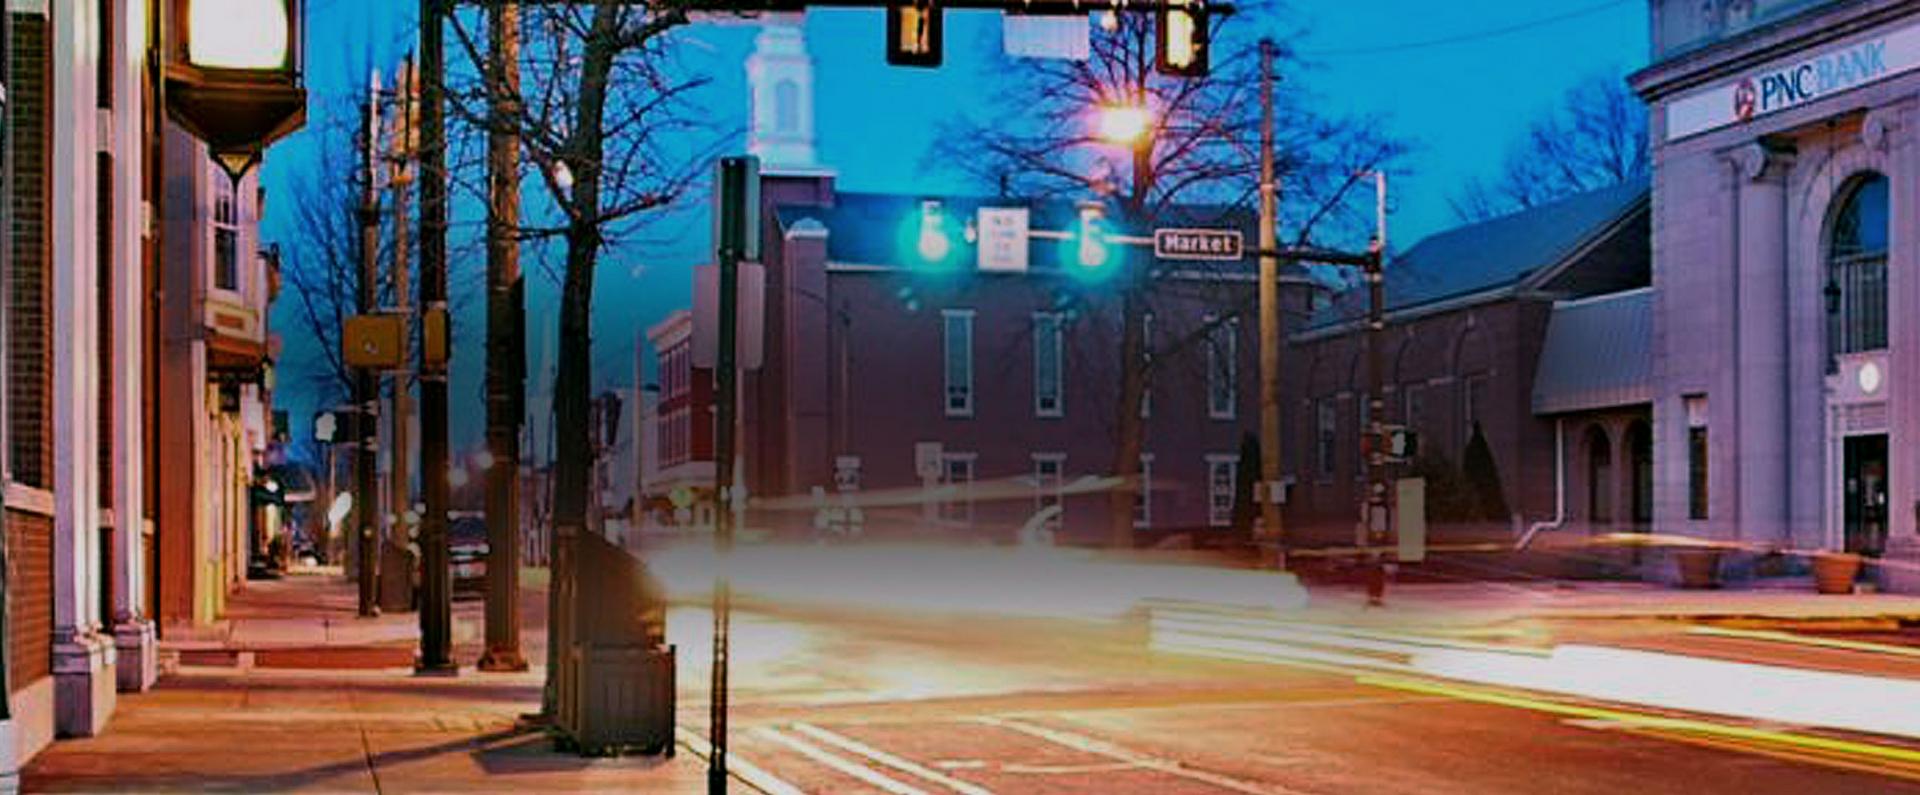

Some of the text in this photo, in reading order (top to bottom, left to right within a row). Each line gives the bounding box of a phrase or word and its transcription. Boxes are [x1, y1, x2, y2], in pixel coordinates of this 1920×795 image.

[1760, 40, 1886, 110] PNC BANK
[1165, 234, 1232, 252] Market
